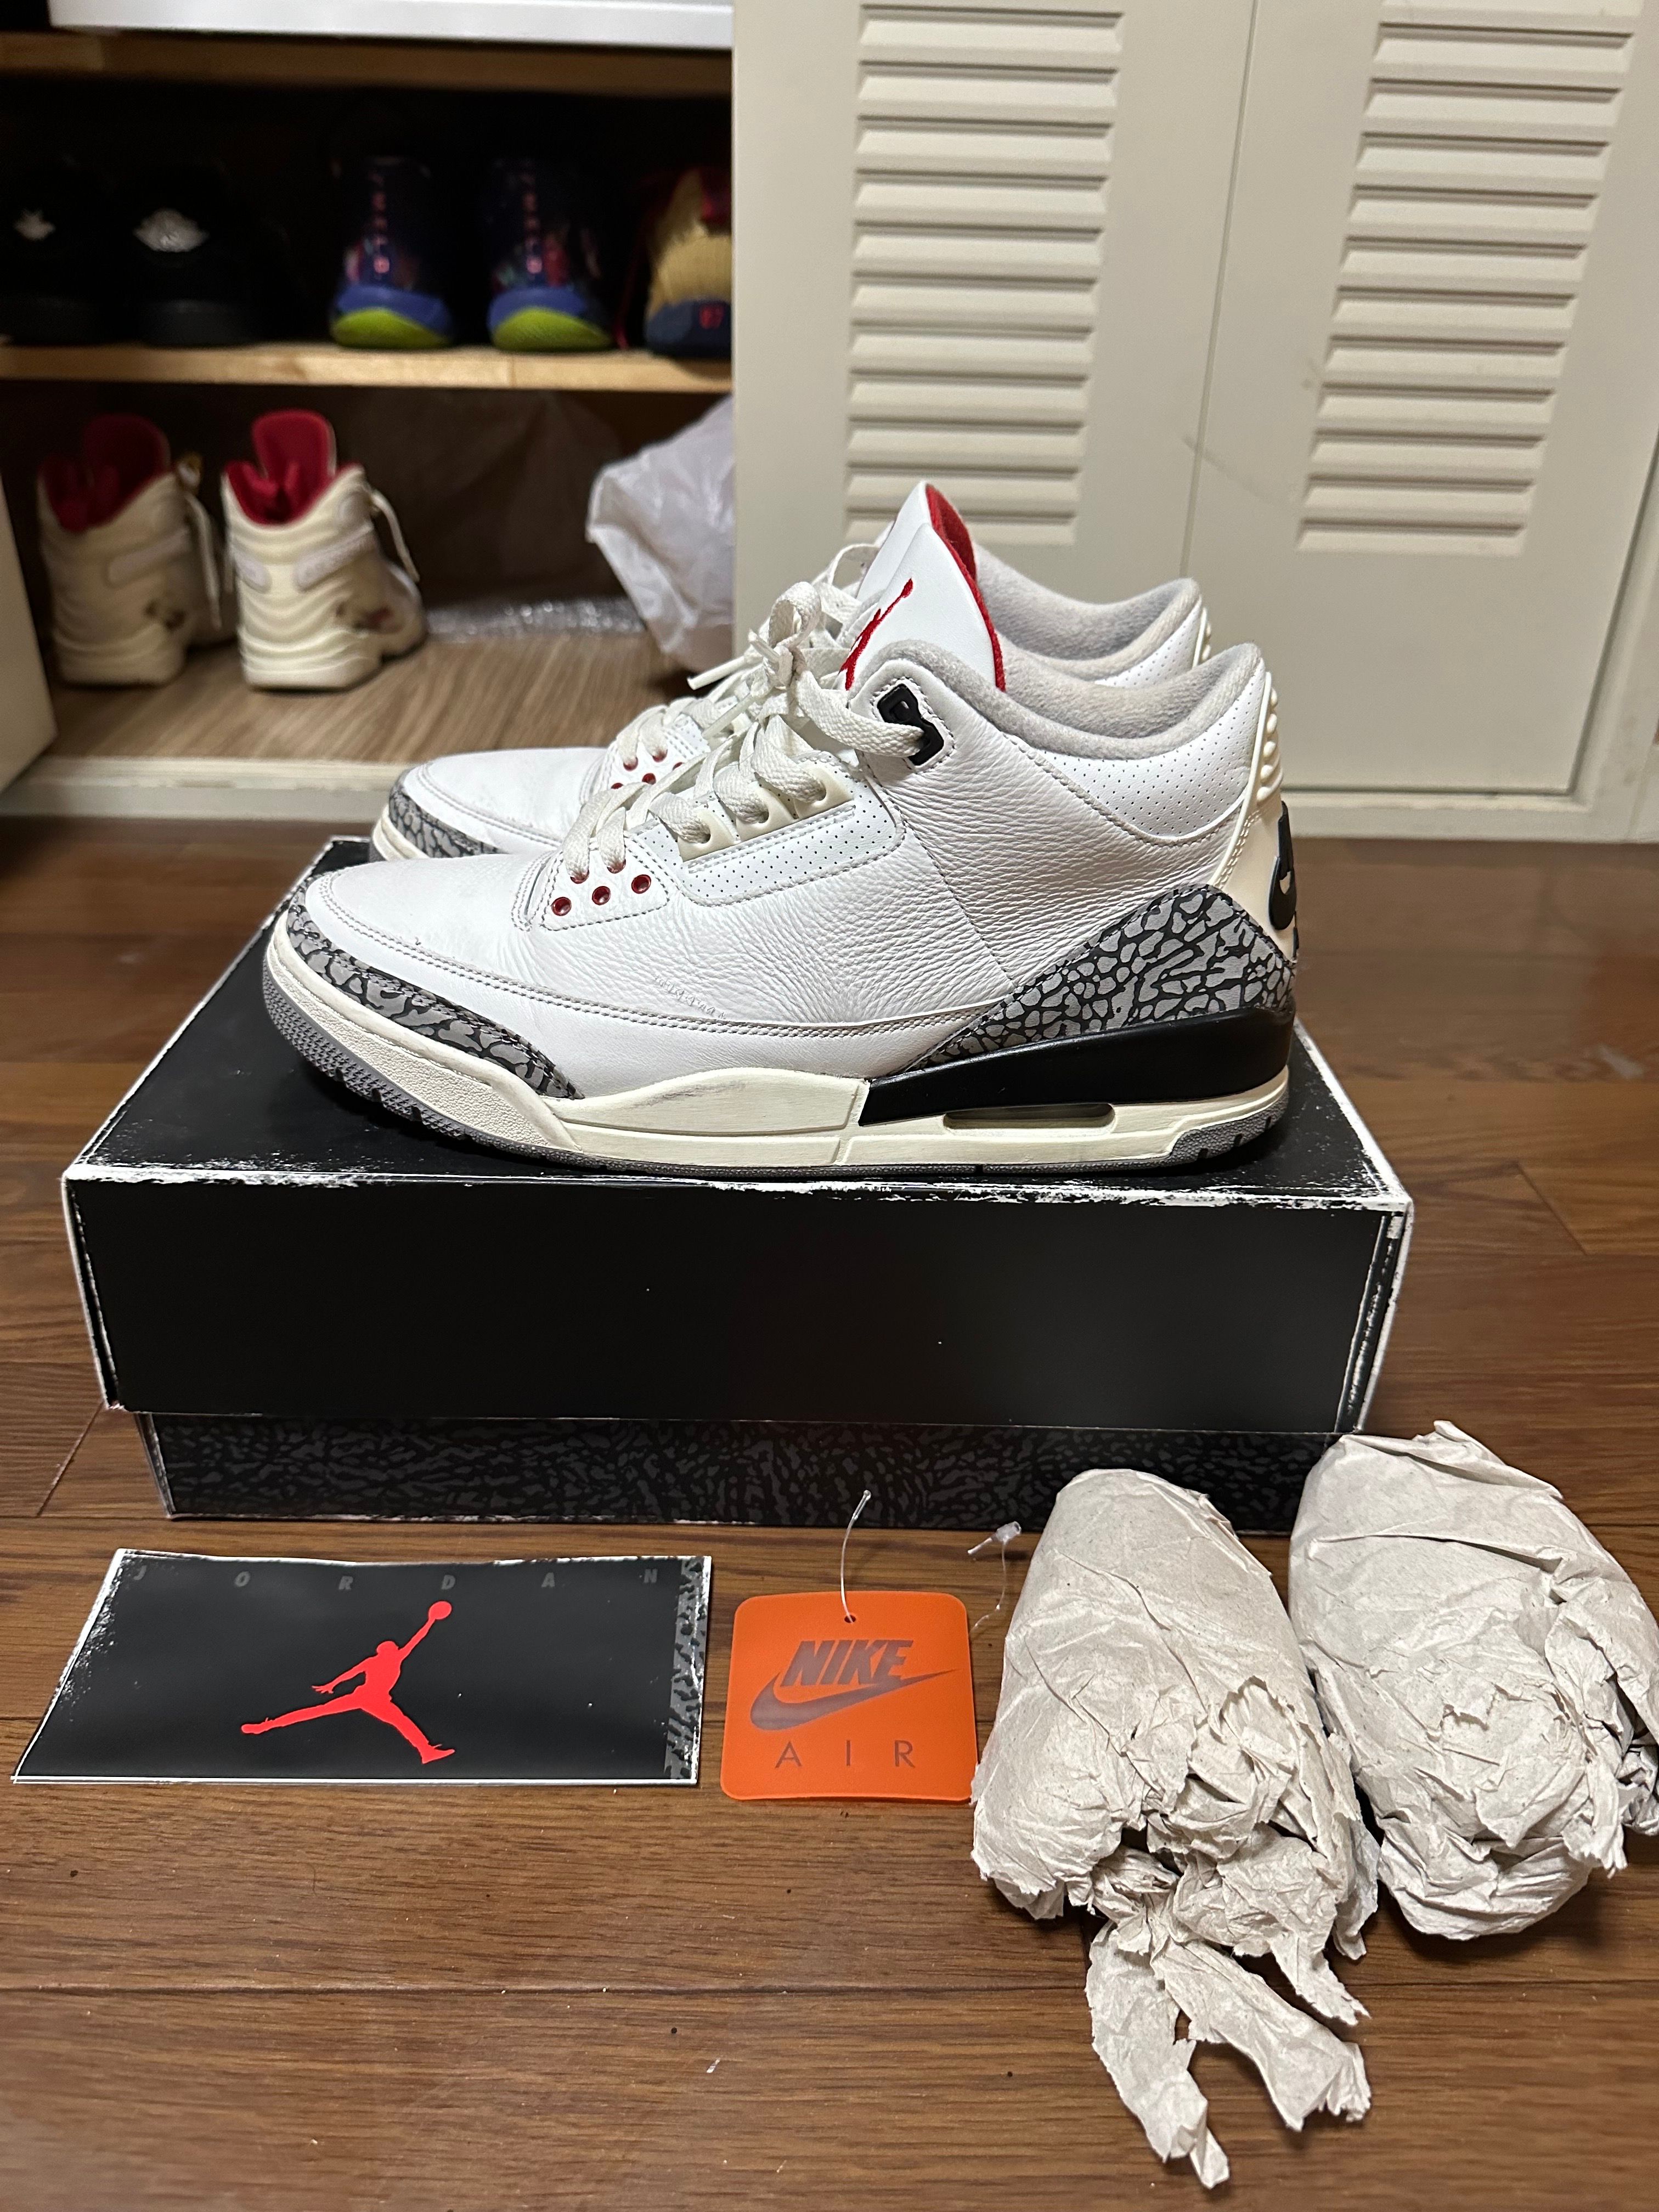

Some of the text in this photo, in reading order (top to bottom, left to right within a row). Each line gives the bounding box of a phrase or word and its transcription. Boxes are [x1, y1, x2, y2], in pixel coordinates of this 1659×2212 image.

[133, 1565, 658, 1590] JORDAN
[780, 1639, 914, 1687] NIKE
[775, 1740, 916, 1768] AIR
